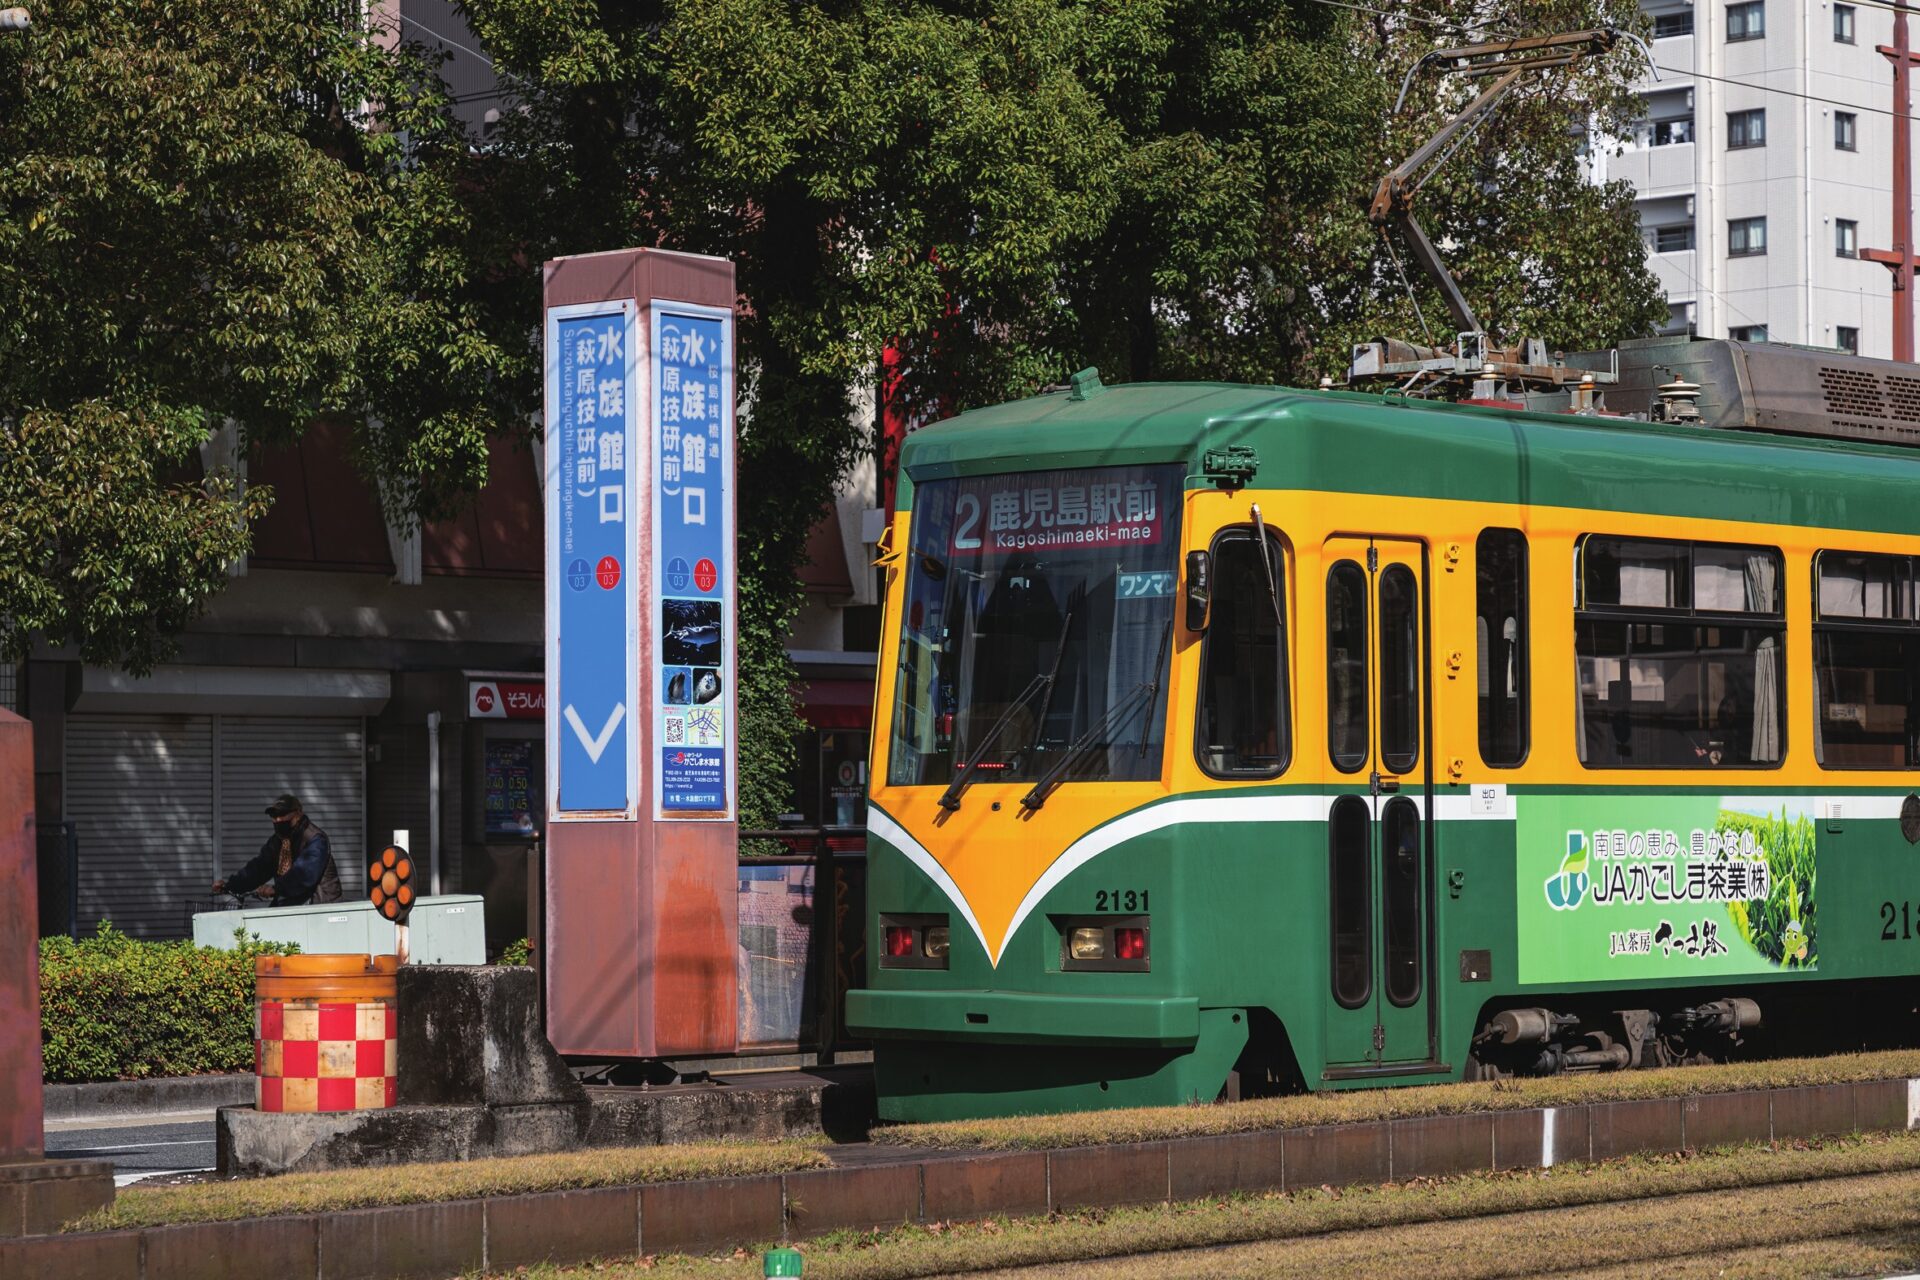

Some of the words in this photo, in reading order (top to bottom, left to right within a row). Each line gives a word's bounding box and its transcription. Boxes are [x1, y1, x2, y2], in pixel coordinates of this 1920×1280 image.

[597, 325, 624, 525] 水族館口
[681, 328, 706, 526] 水族館口
[953, 492, 982, 550] 2
[989, 480, 1158, 531] 鹿児島駅前
[996, 524, 1152, 550] Kagoshimaeki-mae
[604, 560, 612, 570] N
[702, 562, 710, 572] N
[574, 576, 585, 588] 03
[603, 574, 614, 586] 03
[673, 575, 684, 587] 03
[700, 576, 711, 588] 03
[1482, 788, 1496, 799] 出口
[1593, 829, 1765, 858] 南国の恵み、豊かな心。
[1593, 860, 1771, 904] JAかごしま茶業(株)
[1096, 890, 1149, 911] 2131
[1880, 900, 1920, 941] 21
[1608, 930, 1651, 956] JA茶房
